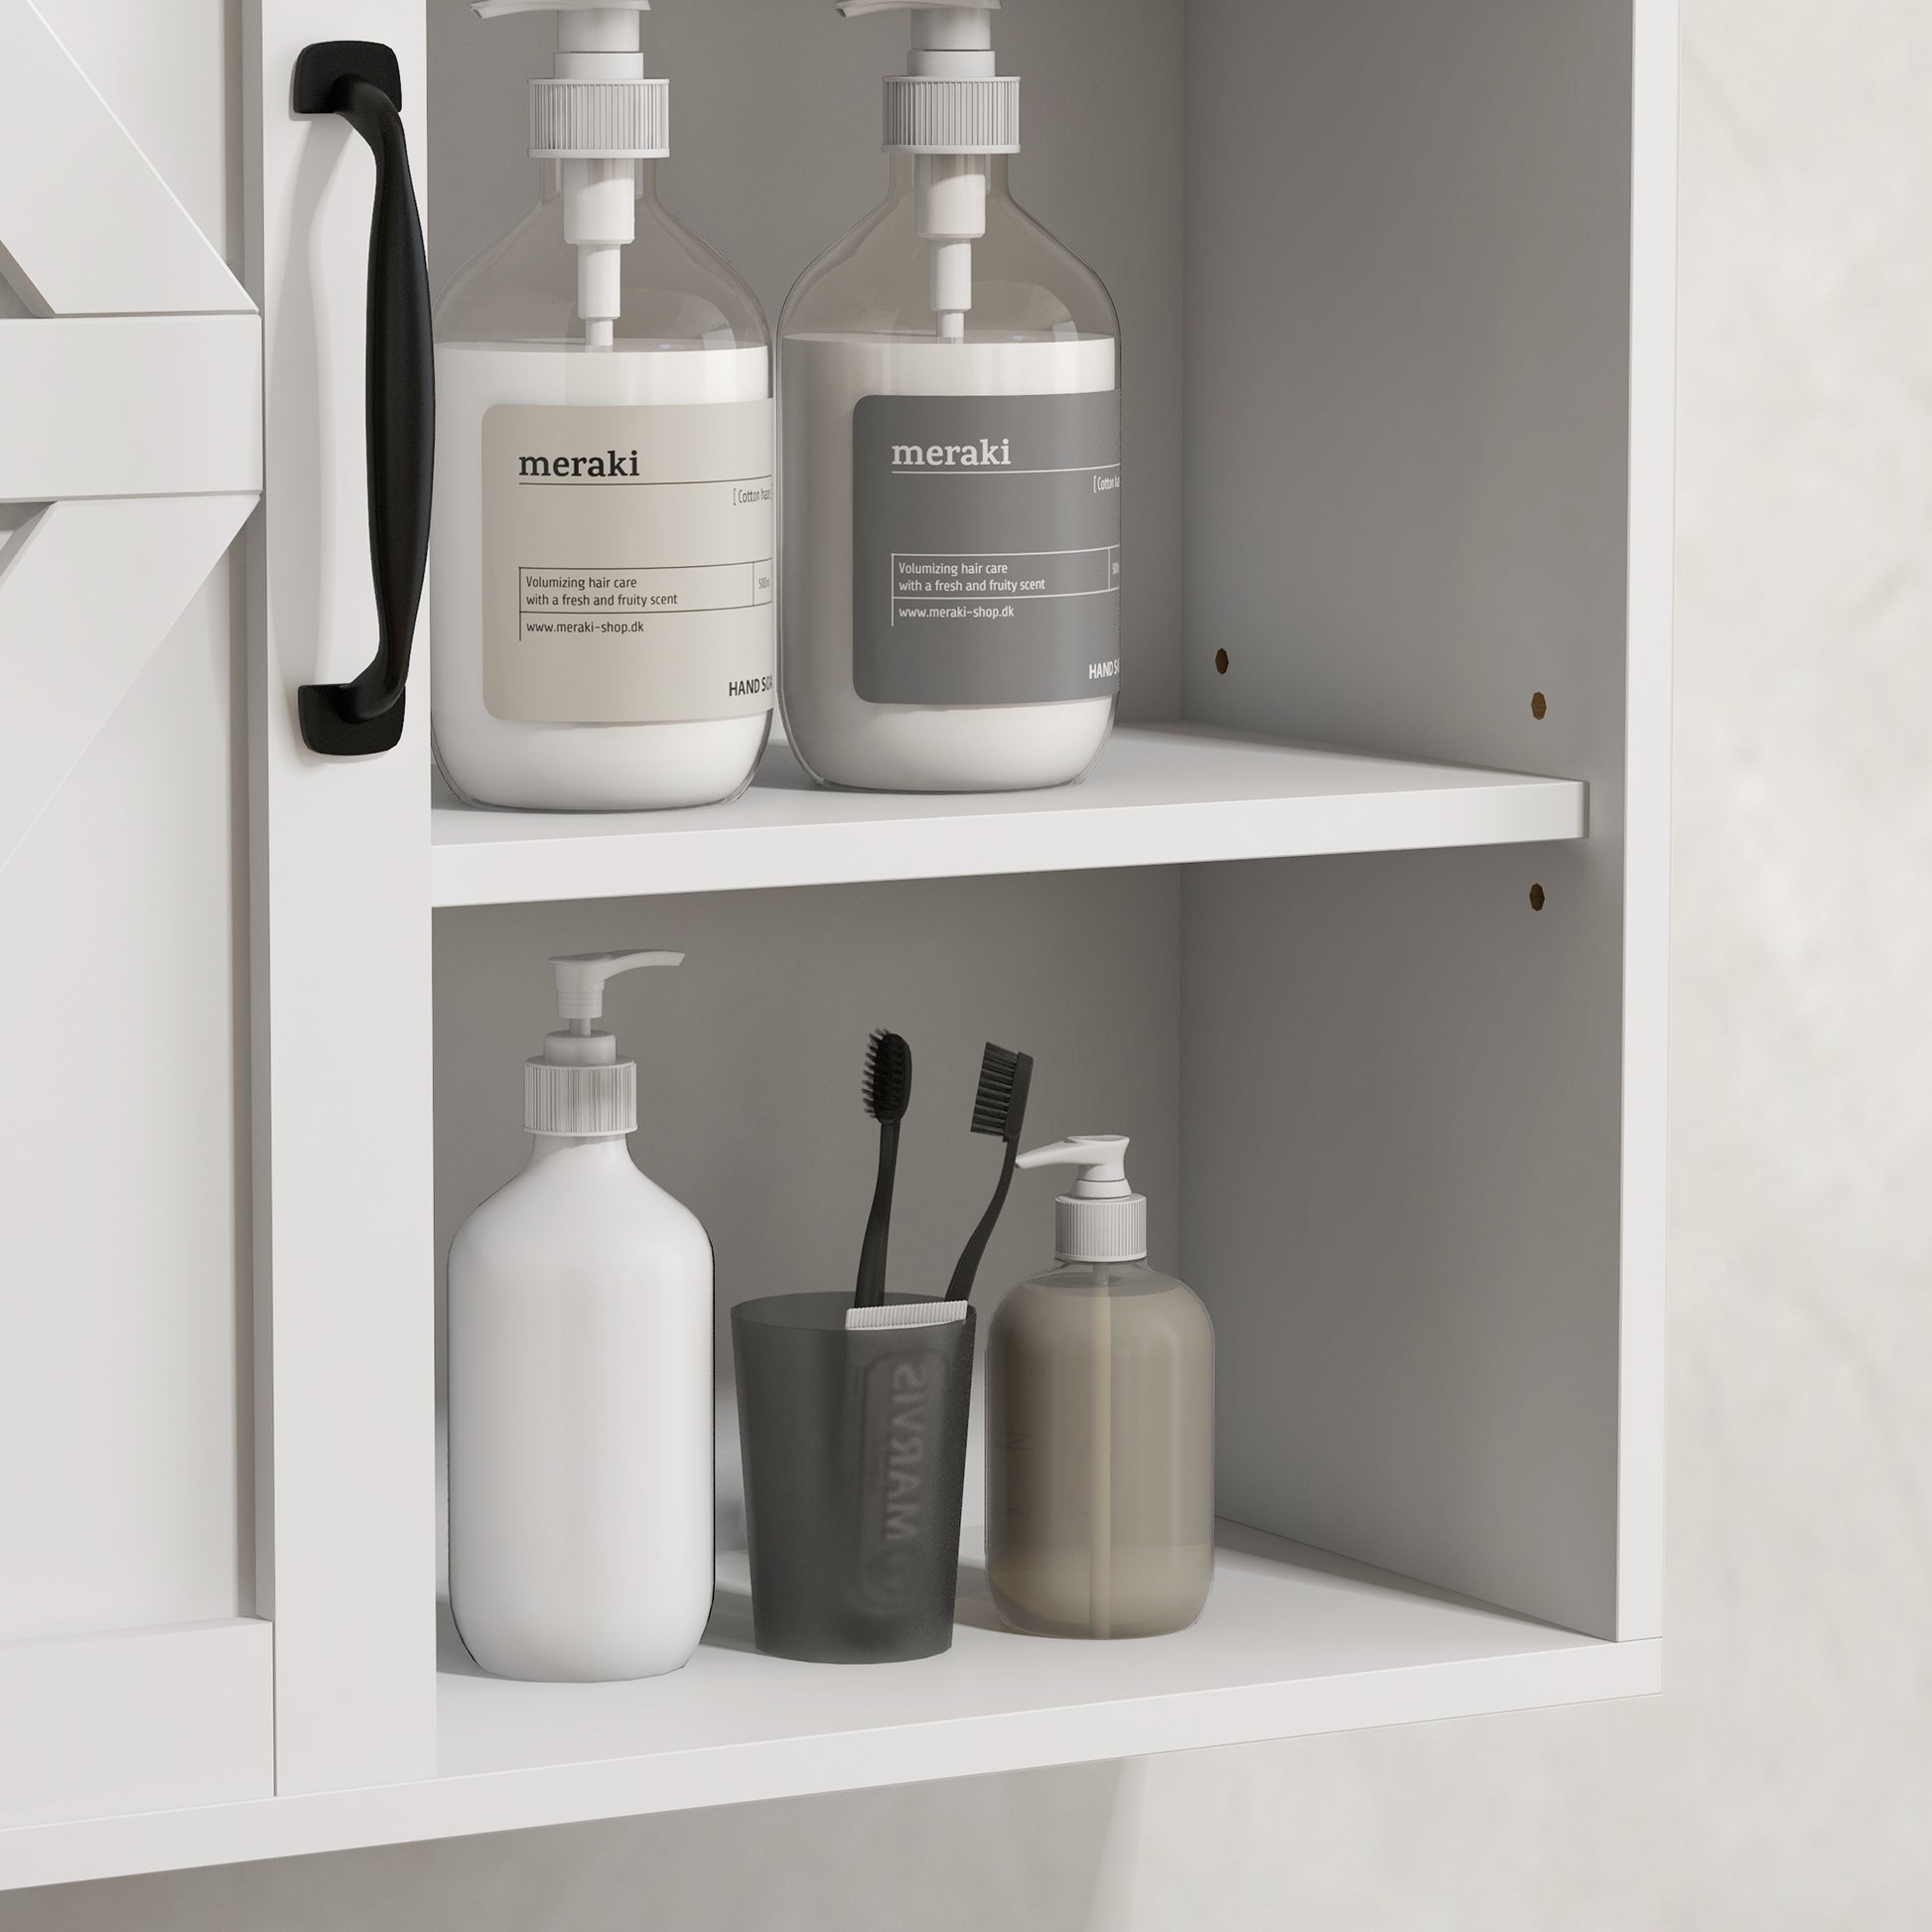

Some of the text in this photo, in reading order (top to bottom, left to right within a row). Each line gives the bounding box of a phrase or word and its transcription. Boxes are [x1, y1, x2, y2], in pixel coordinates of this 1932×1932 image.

[892, 438, 1011, 467] meraki
[518, 450, 640, 477] meraki
[898, 562, 1008, 577] Volumizing hair care
[526, 575, 636, 592] Volumizing hair care
[898, 578, 1045, 594] with a fresh and fruity scent
[526, 593, 677, 608] with a fresh and fruity scent
[898, 606, 1015, 620] www.meraki-shop.dk
[526, 621, 644, 635] www.meraki-shop.dk
[1089, 661, 1113, 679] HAND
[729, 678, 759, 697] HAND
